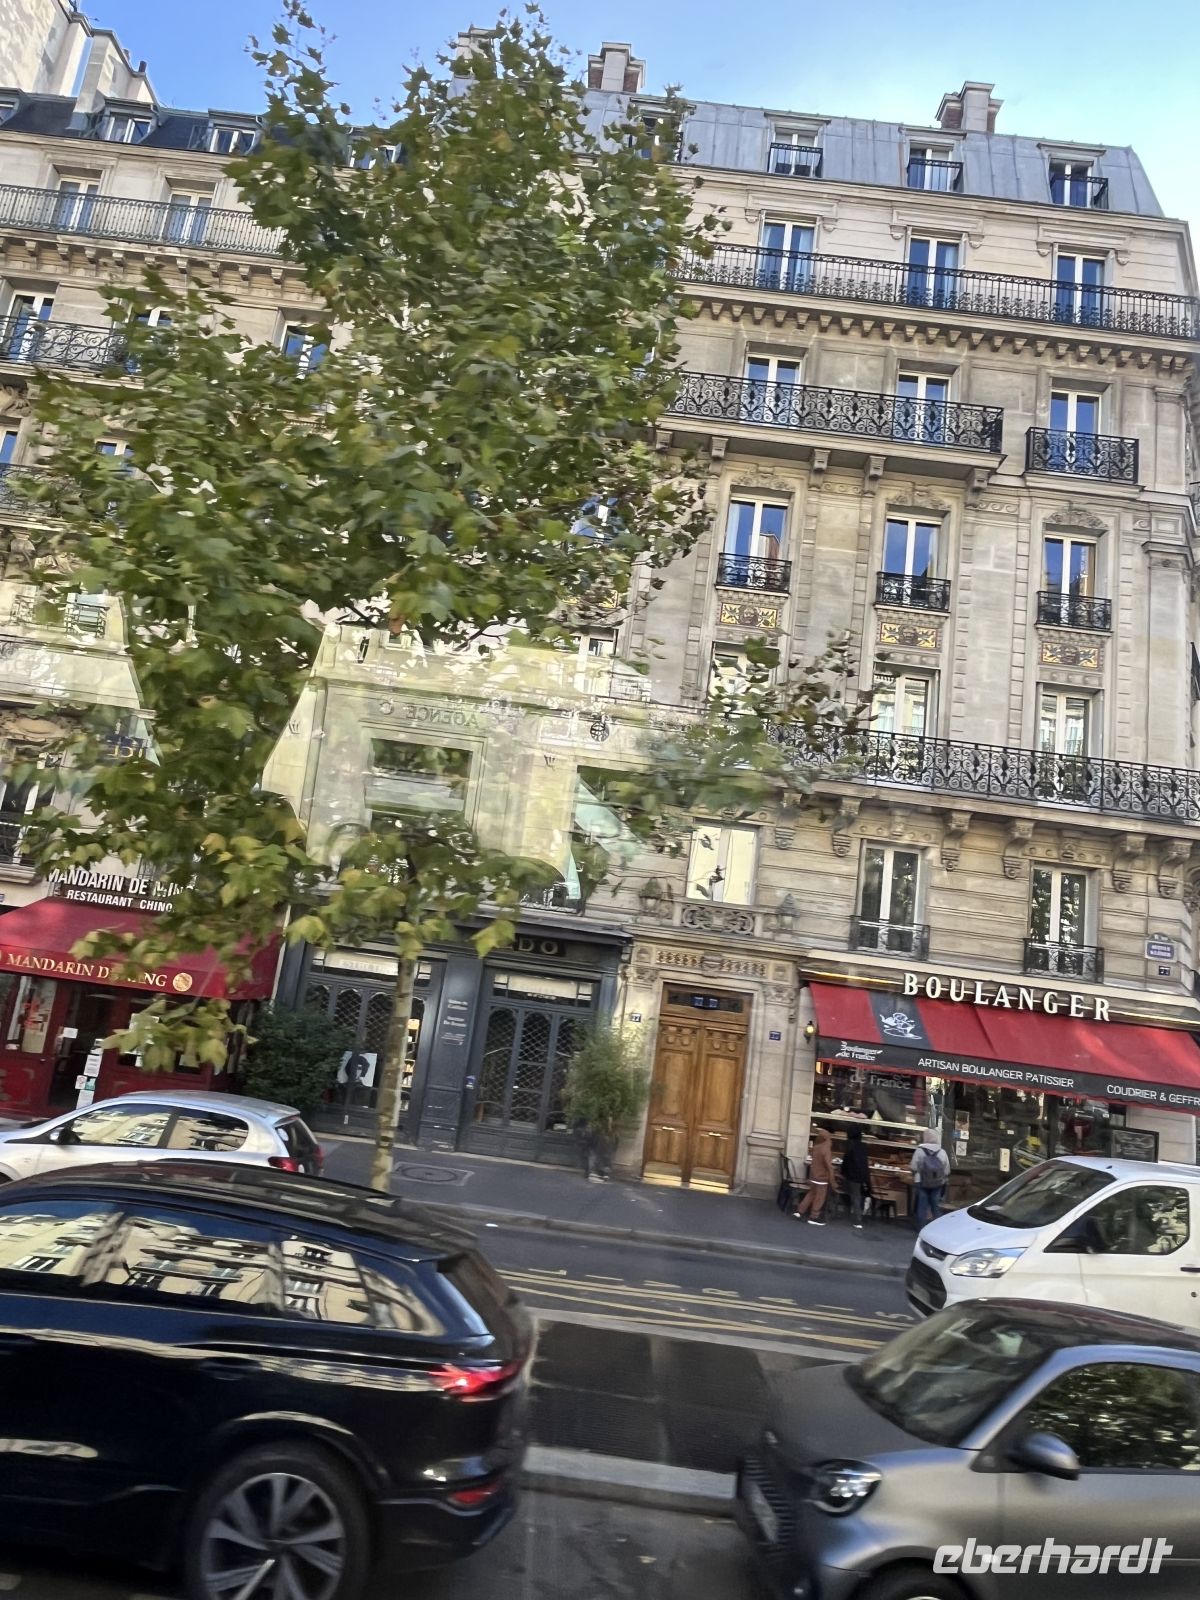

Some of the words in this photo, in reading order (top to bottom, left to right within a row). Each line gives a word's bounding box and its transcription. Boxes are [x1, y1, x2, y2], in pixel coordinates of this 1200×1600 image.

[48, 867, 124, 892] MANDARIN
[128, 877, 149, 895] DE
[66, 889, 134, 908] RESTAURANT
[139, 899, 176, 913] CHINO
[7, 953, 95, 977] MANDARIN
[902, 972, 1110, 1022] BOULANGER
[870, 1074, 912, 1090] France
[917, 1057, 960, 1072] ARTISAN
[961, 1063, 1024, 1081] BOULANGER
[1025, 1072, 1074, 1088] PATISSIER
[1106, 1084, 1157, 1100] COUDRIER
[1159, 1092, 1167, 1101] &
